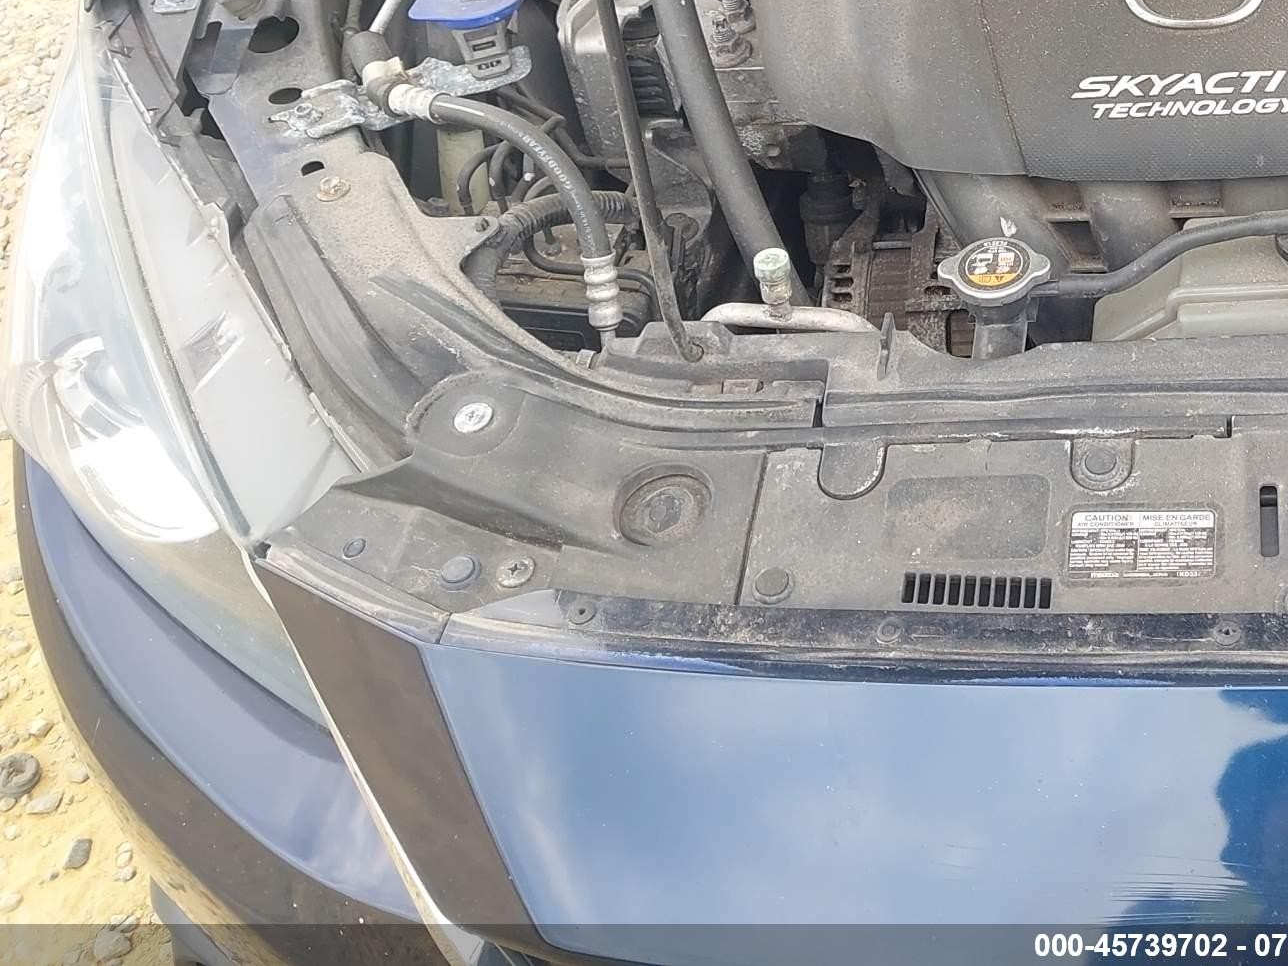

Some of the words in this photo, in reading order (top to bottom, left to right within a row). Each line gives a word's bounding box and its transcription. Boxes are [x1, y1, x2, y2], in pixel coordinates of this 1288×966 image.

[521, 134, 575, 190] GOODYEAR
[1085, 514, 1129, 522] CAUTION
[1142, 514, 1164, 522] MISE
[1166, 514, 1179, 522] EN
[1179, 513, 1211, 522] GARDE
